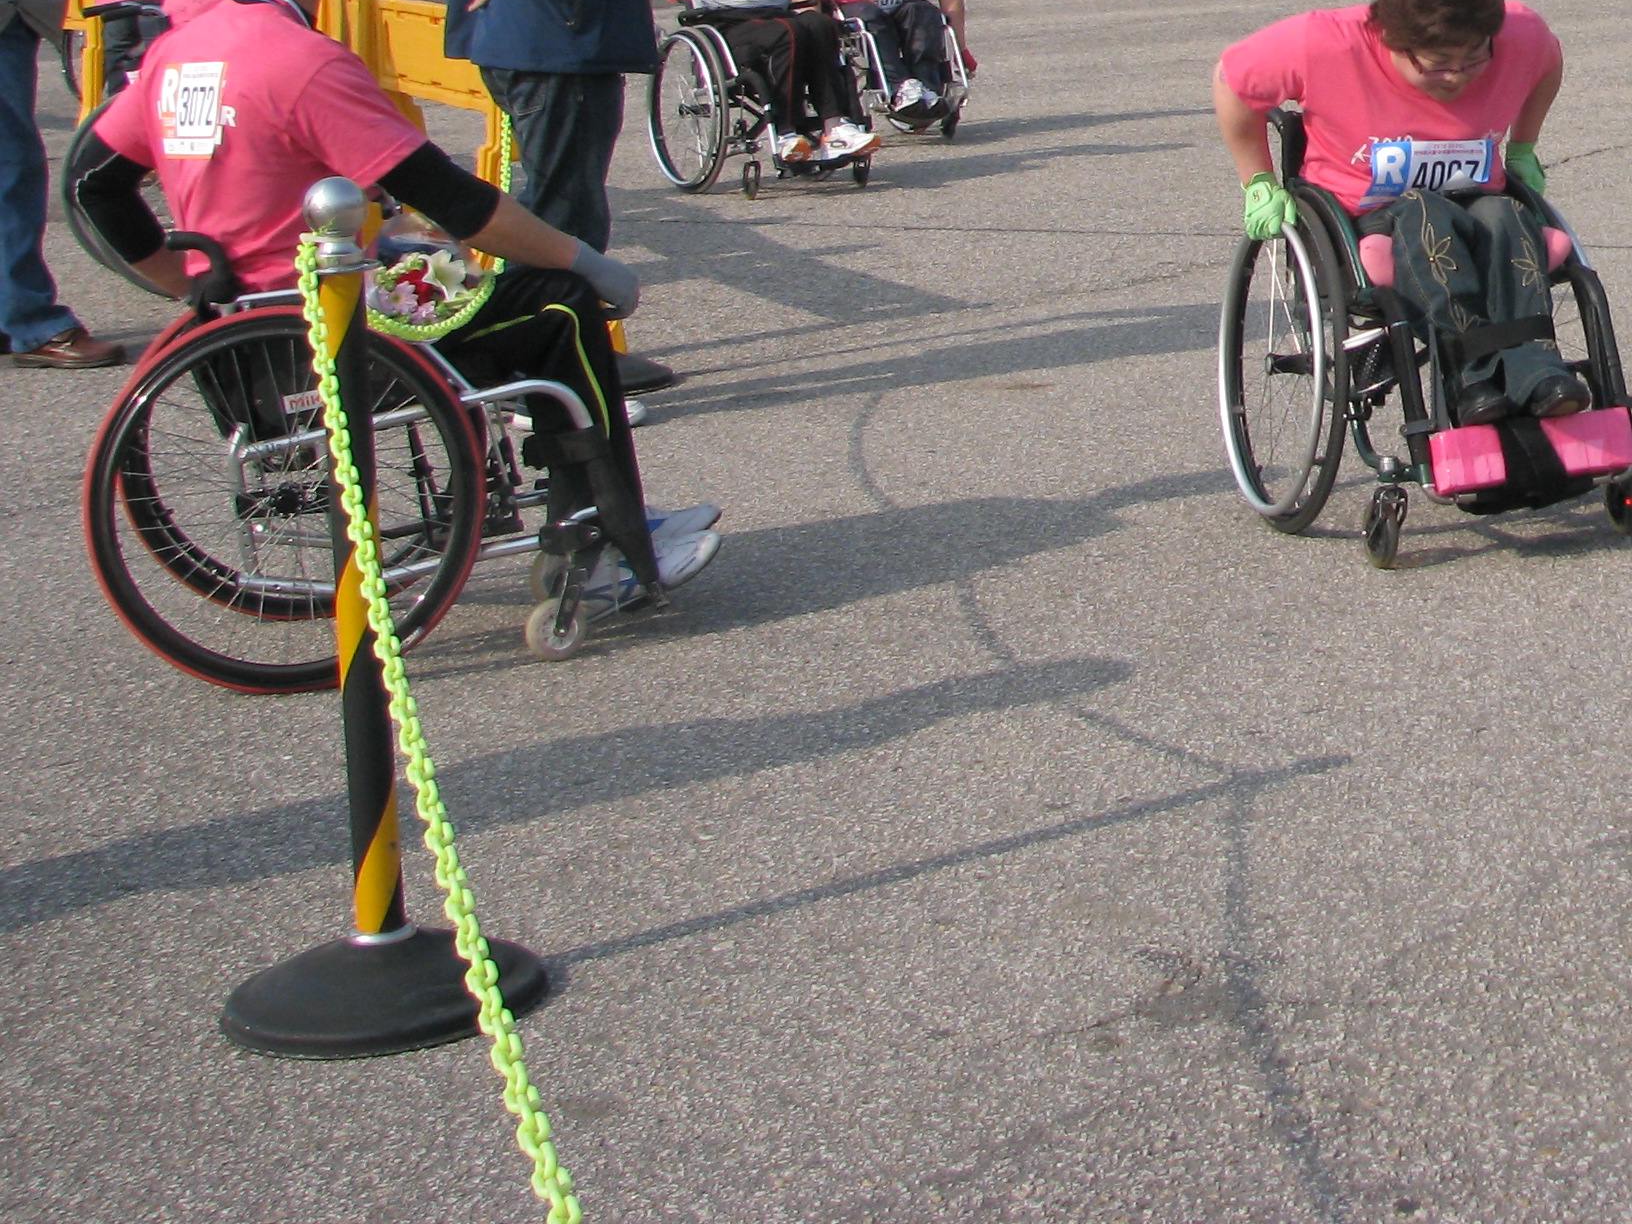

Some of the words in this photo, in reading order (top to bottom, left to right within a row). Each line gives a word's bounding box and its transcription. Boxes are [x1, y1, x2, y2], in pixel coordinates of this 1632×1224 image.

[162, 68, 179, 113] R
[179, 85, 216, 127] 3072
[1376, 146, 1406, 185] R
